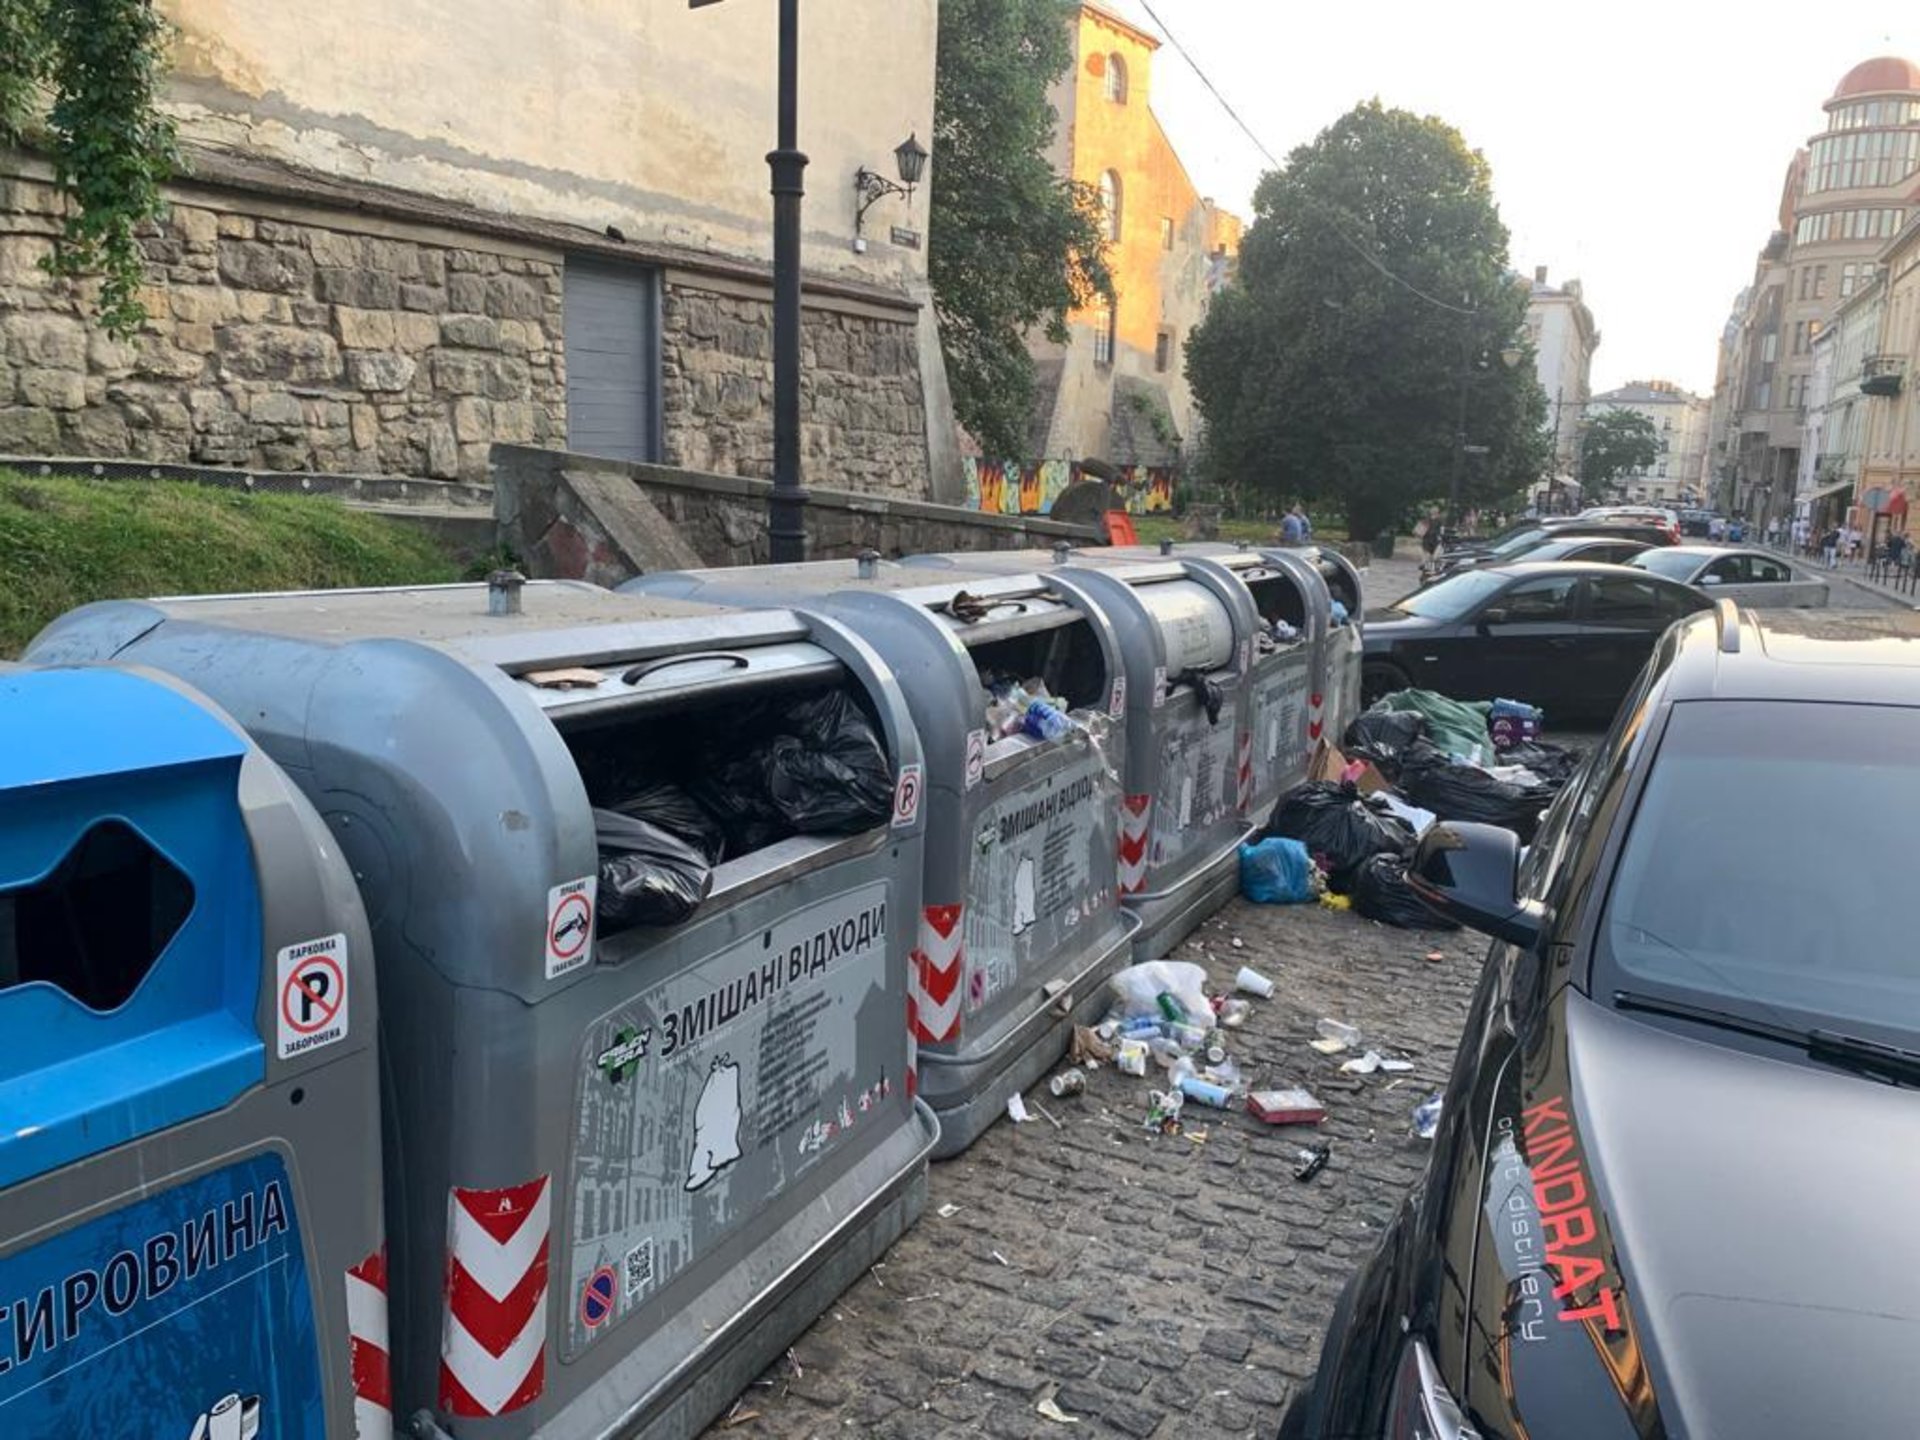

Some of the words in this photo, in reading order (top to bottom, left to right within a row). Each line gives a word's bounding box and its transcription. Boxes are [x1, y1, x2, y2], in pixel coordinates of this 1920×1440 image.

[289, 939, 336, 960] ПАРКОВКА
[302, 971, 329, 1022] P
[661, 955, 783, 1056] ЗМІШАНІ
[788, 904, 886, 983] ВІДХОДИ
[285, 1027, 341, 1055] ЗАБОРОНЕНА
[1497, 1117, 1520, 1180] craft
[1509, 1195, 1546, 1340] distillery
[1521, 1096, 1620, 1330] KINDRAT
